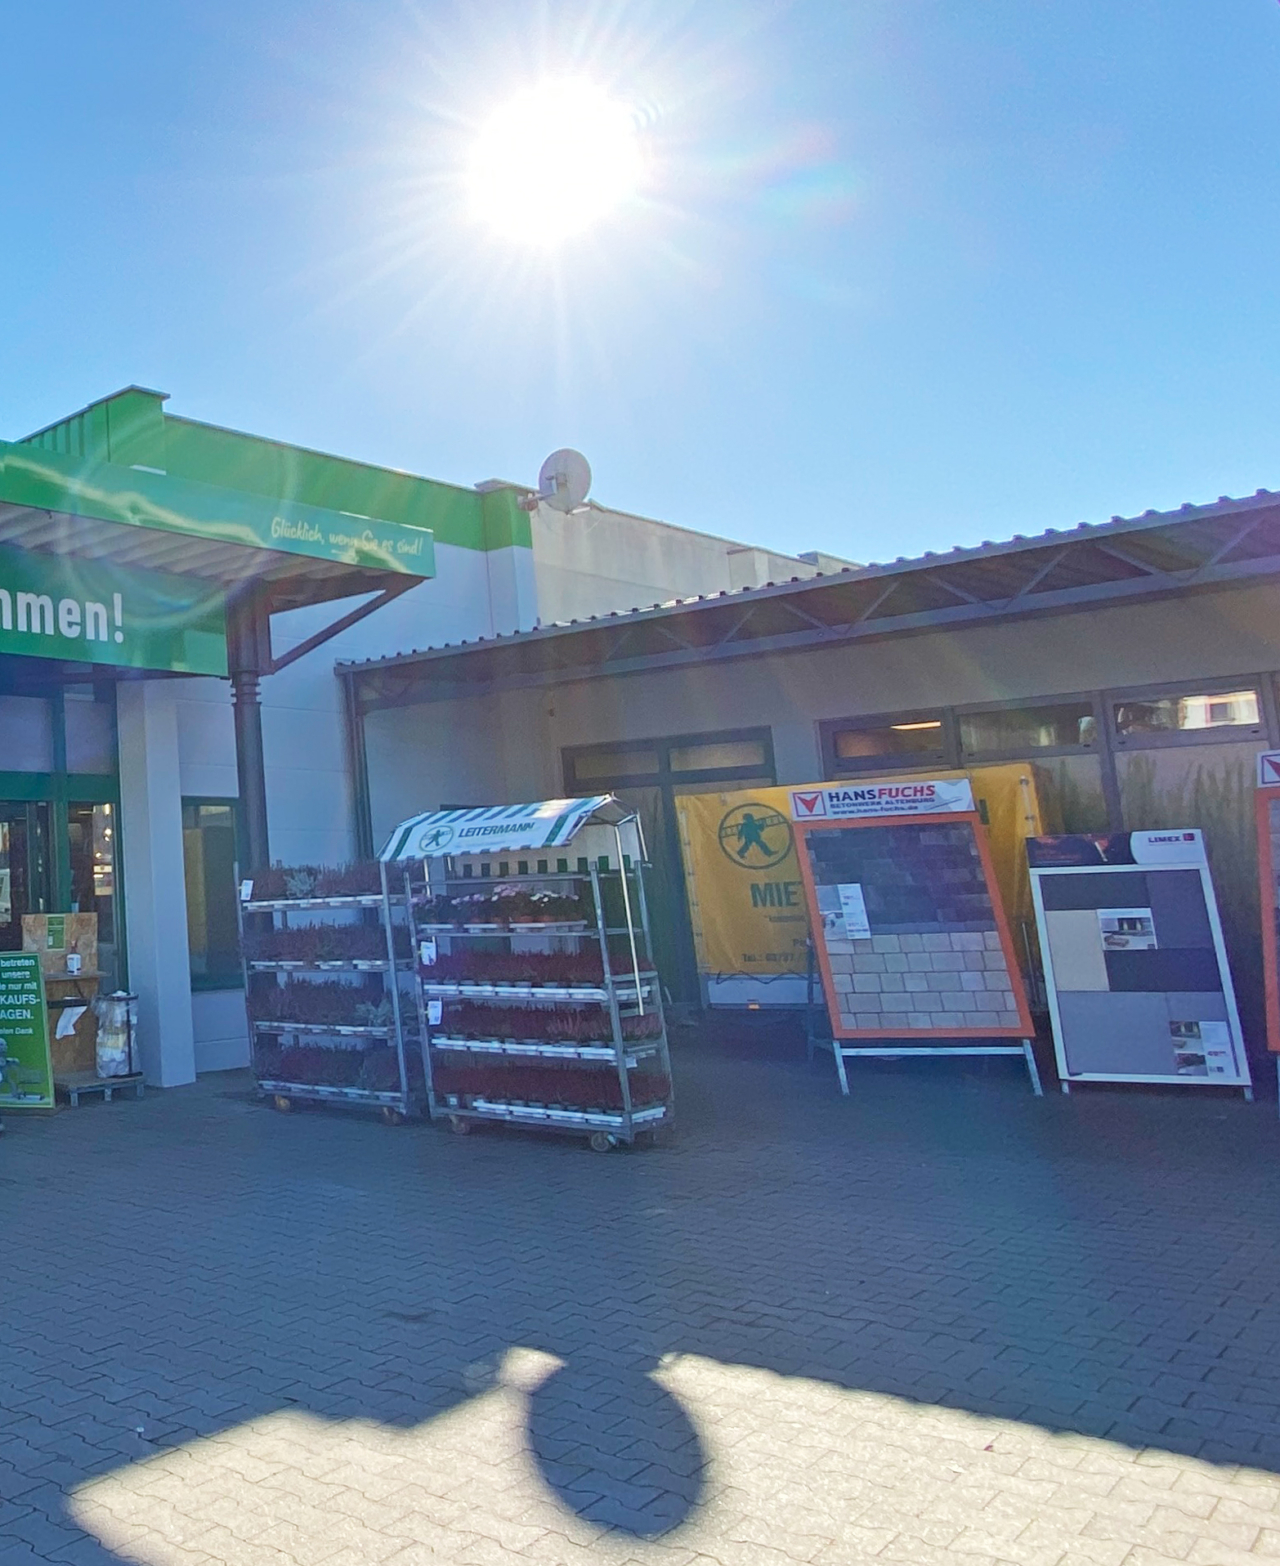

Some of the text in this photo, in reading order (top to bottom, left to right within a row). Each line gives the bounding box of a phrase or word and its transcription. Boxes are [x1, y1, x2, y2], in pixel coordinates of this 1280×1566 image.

[827, 785, 937, 803] HANSFUCHS
[830, 800, 882, 809] BETONWERK
[457, 822, 536, 838] LEITERMANN
[0, 958, 36, 968] betreten
[24, 981, 38, 990] mit
